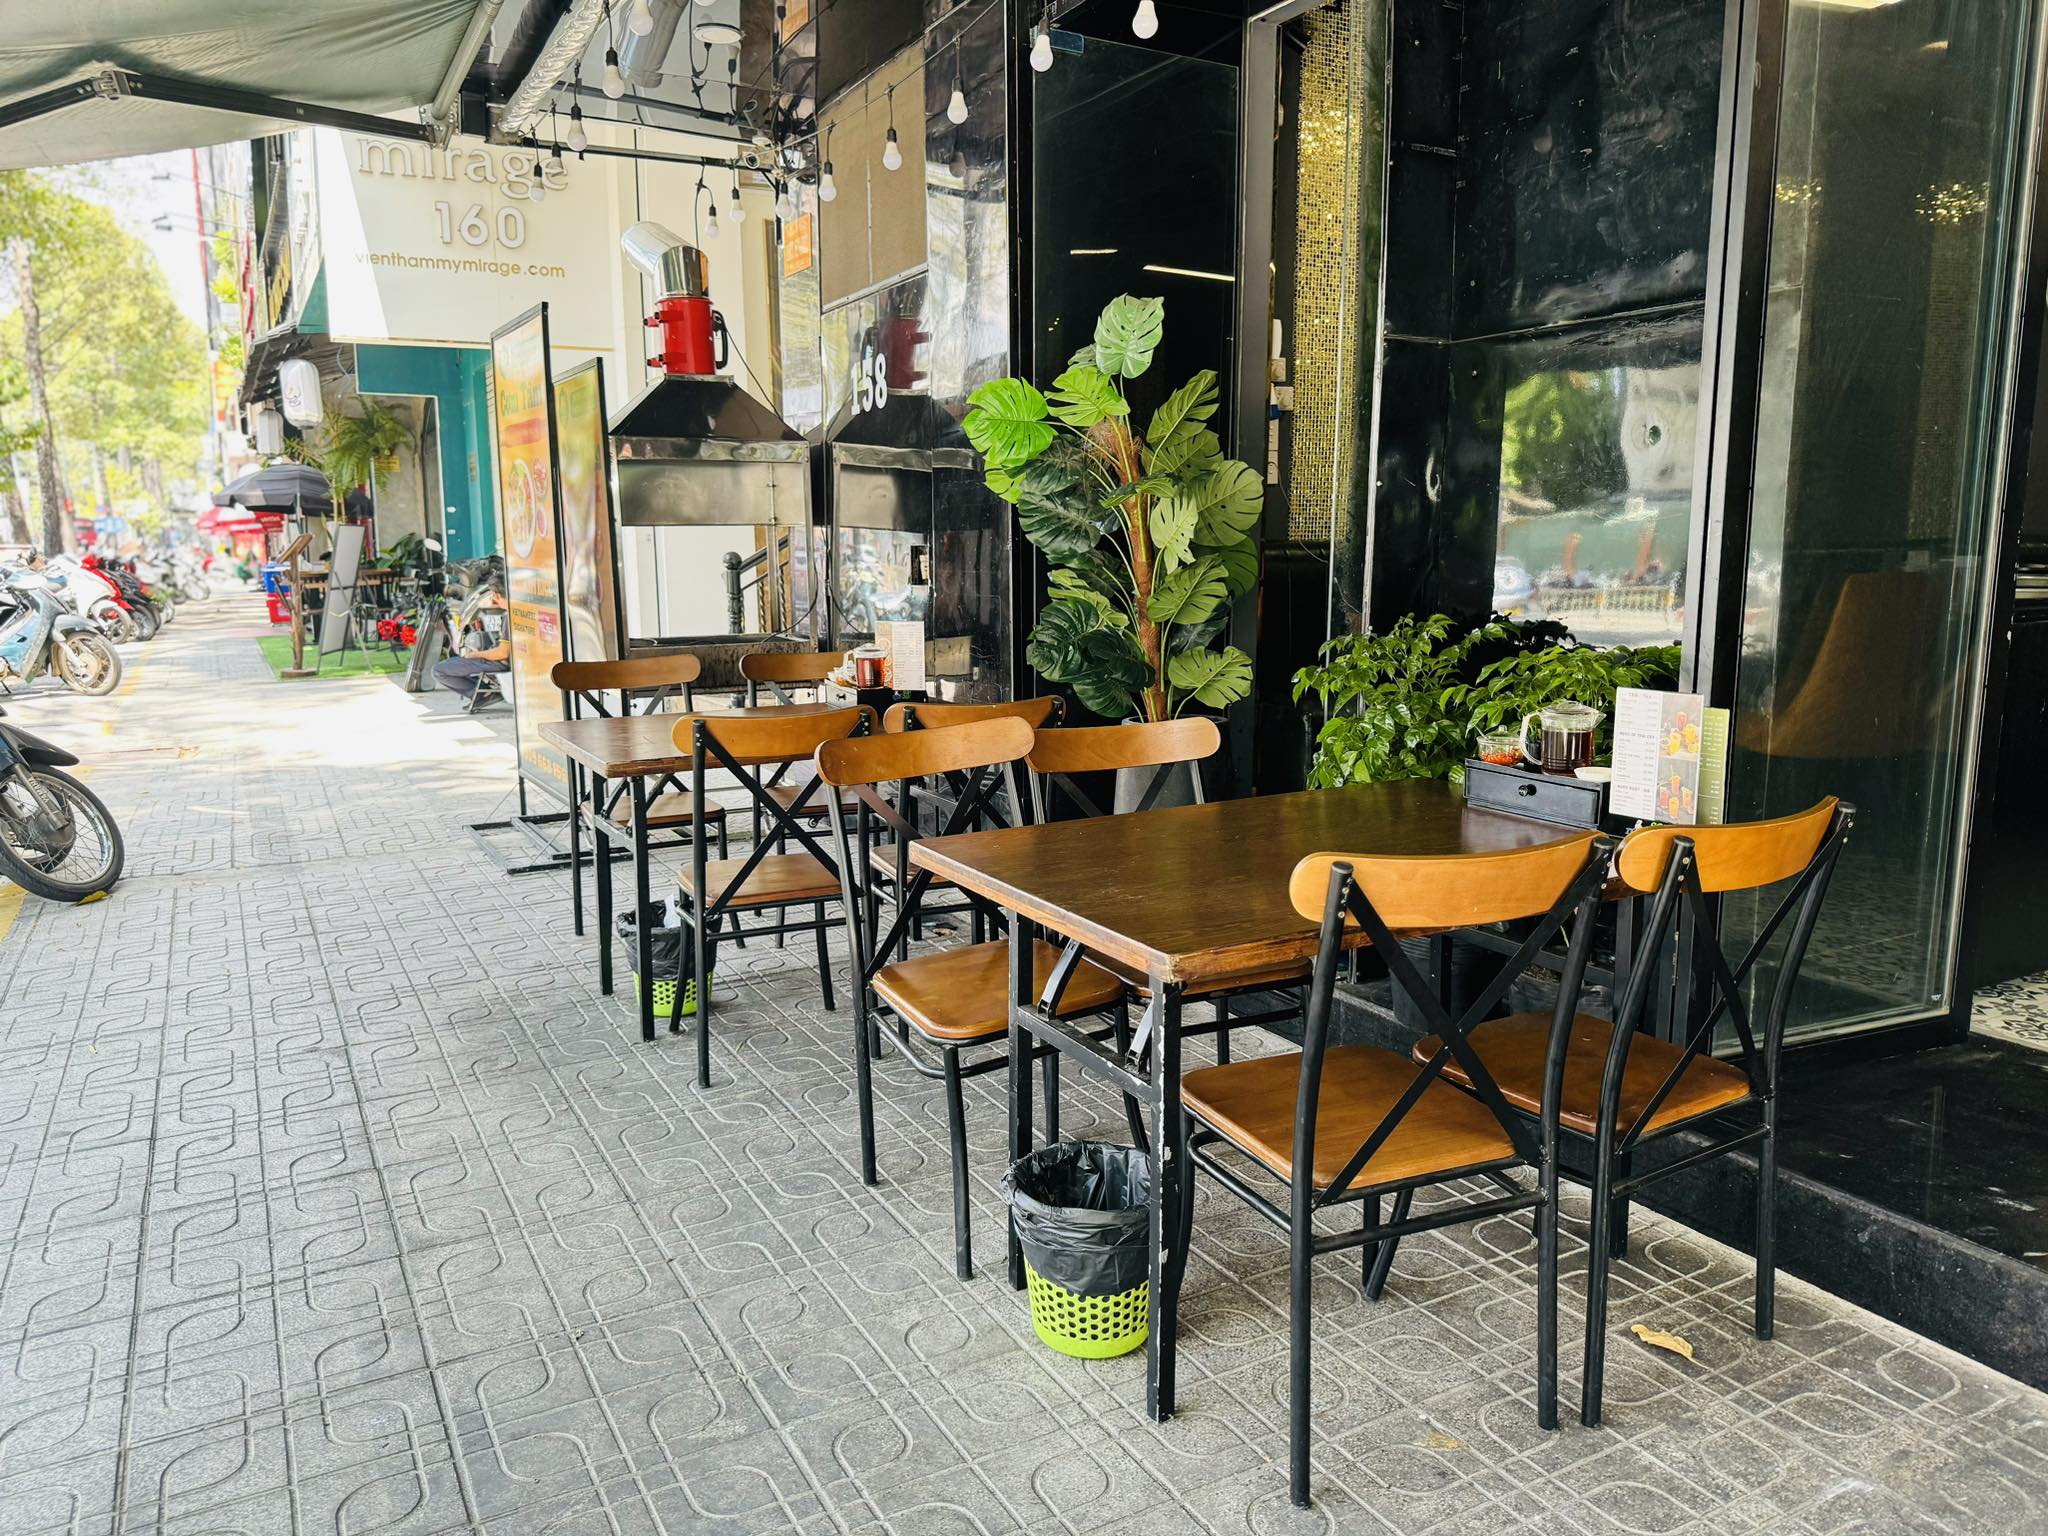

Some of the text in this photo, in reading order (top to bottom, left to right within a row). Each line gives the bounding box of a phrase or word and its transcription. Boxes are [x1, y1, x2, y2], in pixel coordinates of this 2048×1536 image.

[357, 138, 568, 200] mirage
[434, 200, 526, 250] 160
[354, 251, 566, 279] vienthammymirage.com
[851, 353, 888, 416] 158
